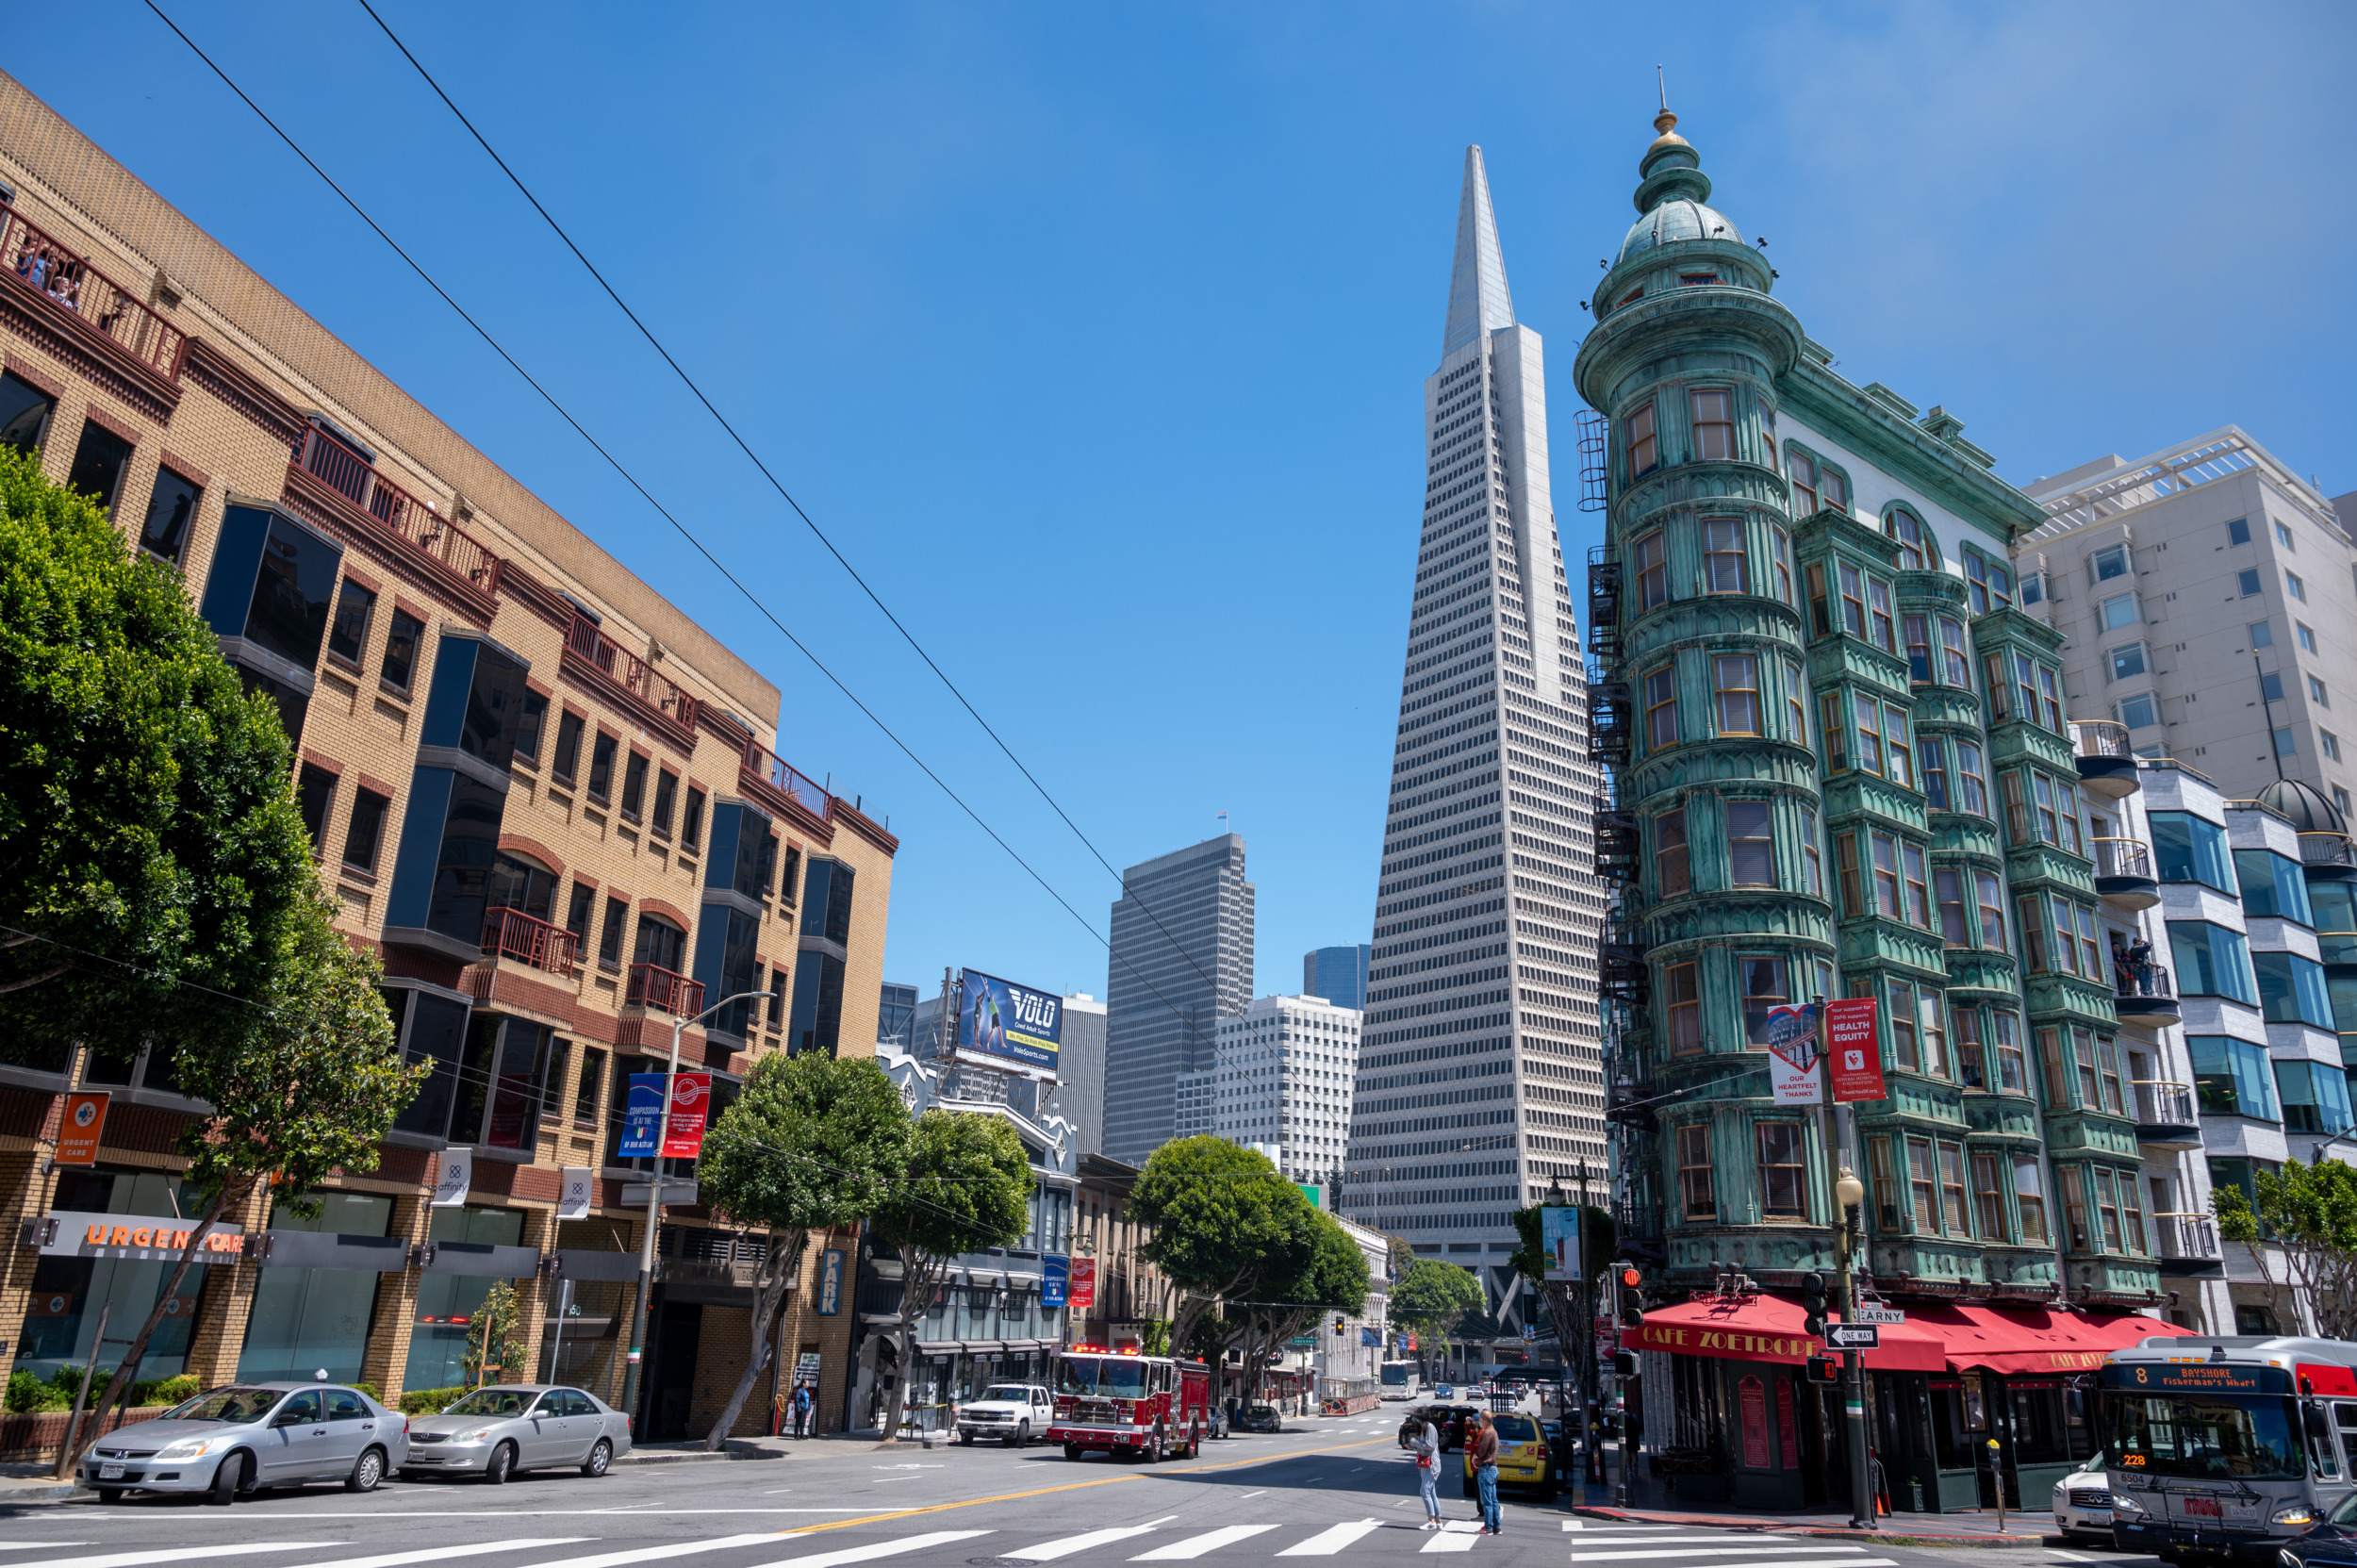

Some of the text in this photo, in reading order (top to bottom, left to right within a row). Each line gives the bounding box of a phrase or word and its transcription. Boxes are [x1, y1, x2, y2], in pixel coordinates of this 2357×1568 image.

[1009, 988, 1056, 1028] VOLO
[1026, 1025, 1037, 1033] Adult
[1038, 1028, 1051, 1037] Sports
[1833, 1021, 1870, 1031] HEALTH
[1834, 1032, 1869, 1042] EQUITY
[1014, 1046, 1049, 1061] VoloSports.com
[630, 1106, 659, 1115] COMPASSION
[438, 1182, 467, 1193] affinity
[563, 1197, 590, 1208] affinity
[87, 1225, 245, 1253] URGEN CARE
[821, 1252, 840, 1313] PARK
[1643, 1326, 1689, 1346] CAFE
[1841, 1332, 1871, 1340] ONE WAY
[1825, 1362, 1835, 1378] 10
[2135, 1367, 2232, 1384] 8 BAYSHORE
[2163, 1377, 2256, 1388] Fisherman's Wharf
[2123, 1454, 2146, 1466] 228
[2121, 1473, 2144, 1484] 6504
